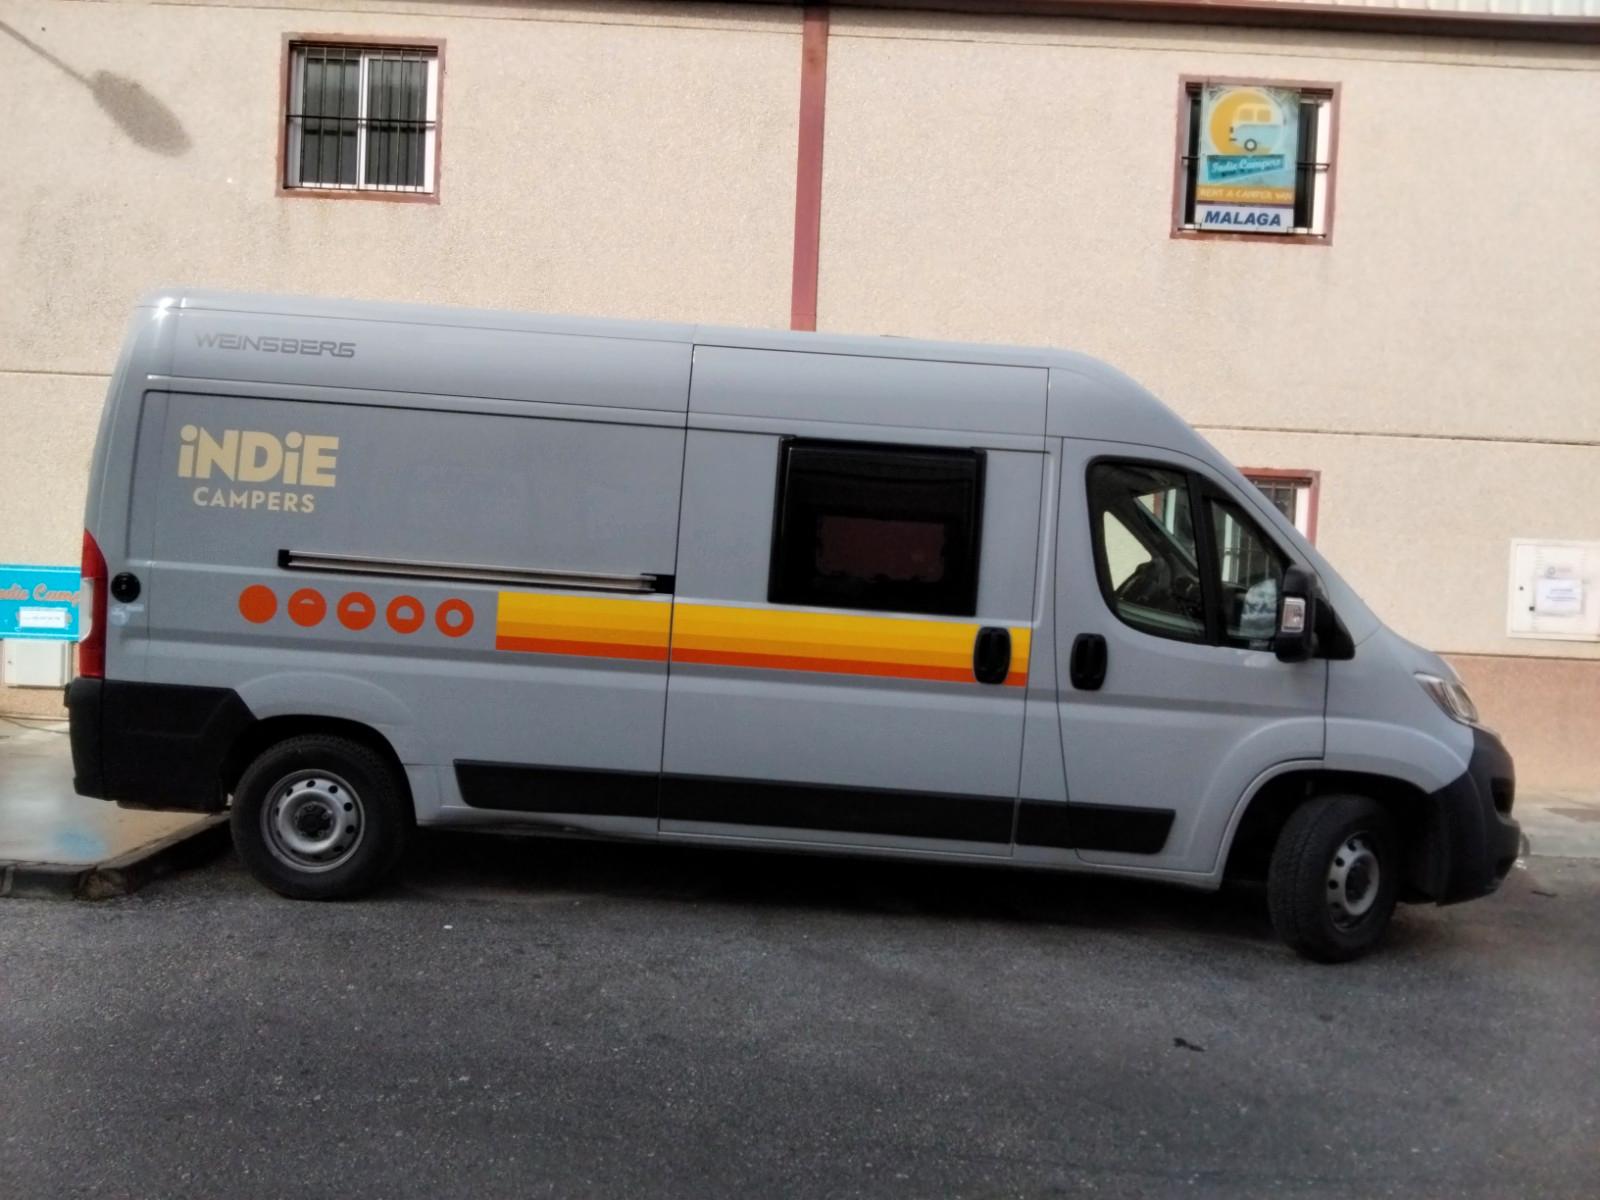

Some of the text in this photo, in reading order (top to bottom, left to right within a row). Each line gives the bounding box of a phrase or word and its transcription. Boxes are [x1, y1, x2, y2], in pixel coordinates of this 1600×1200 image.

[1204, 210, 1281, 226] MALAGA
[195, 333, 356, 358] WEINSBERG
[192, 486, 315, 514] CAMPERS
